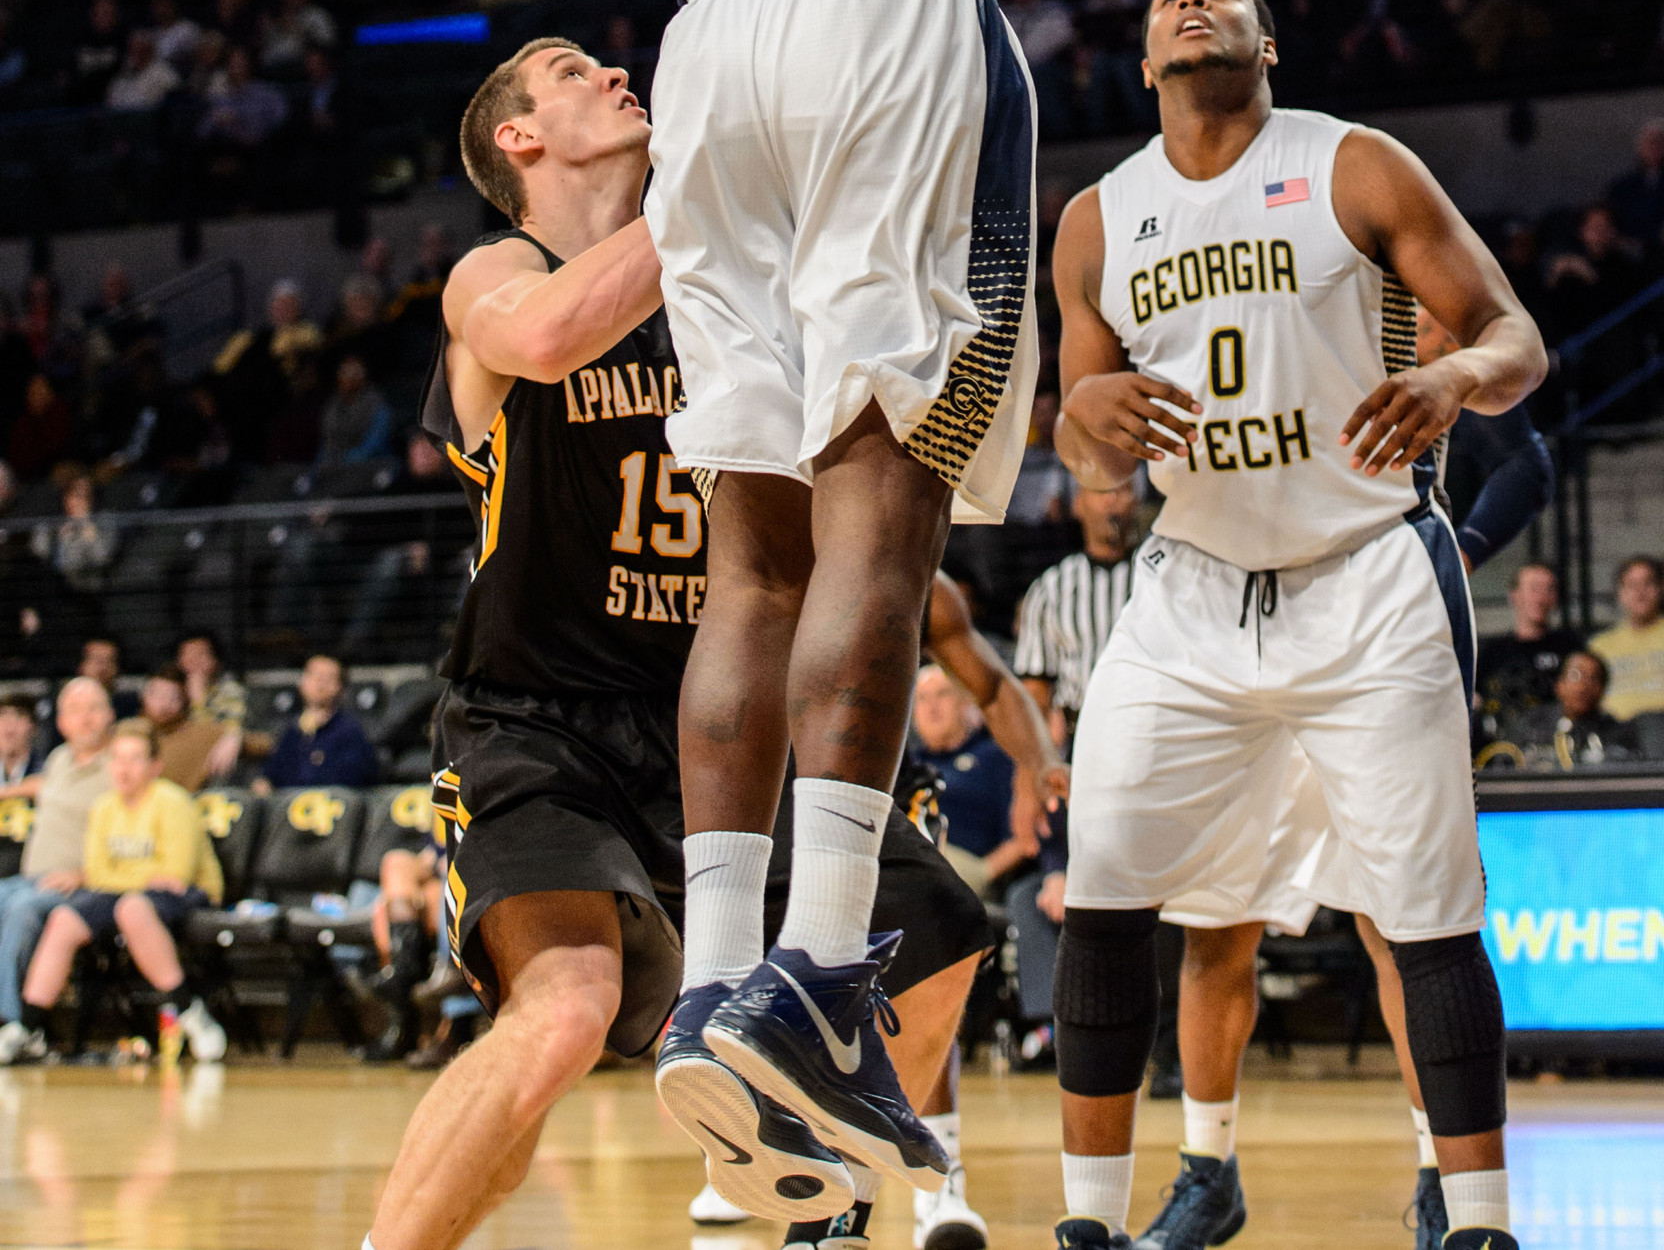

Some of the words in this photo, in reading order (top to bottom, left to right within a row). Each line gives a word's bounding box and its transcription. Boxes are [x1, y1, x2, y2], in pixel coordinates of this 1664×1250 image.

[1130, 239, 1299, 326] GEORGIA
[611, 451, 702, 558] 15
[605, 565, 707, 625] STATE
